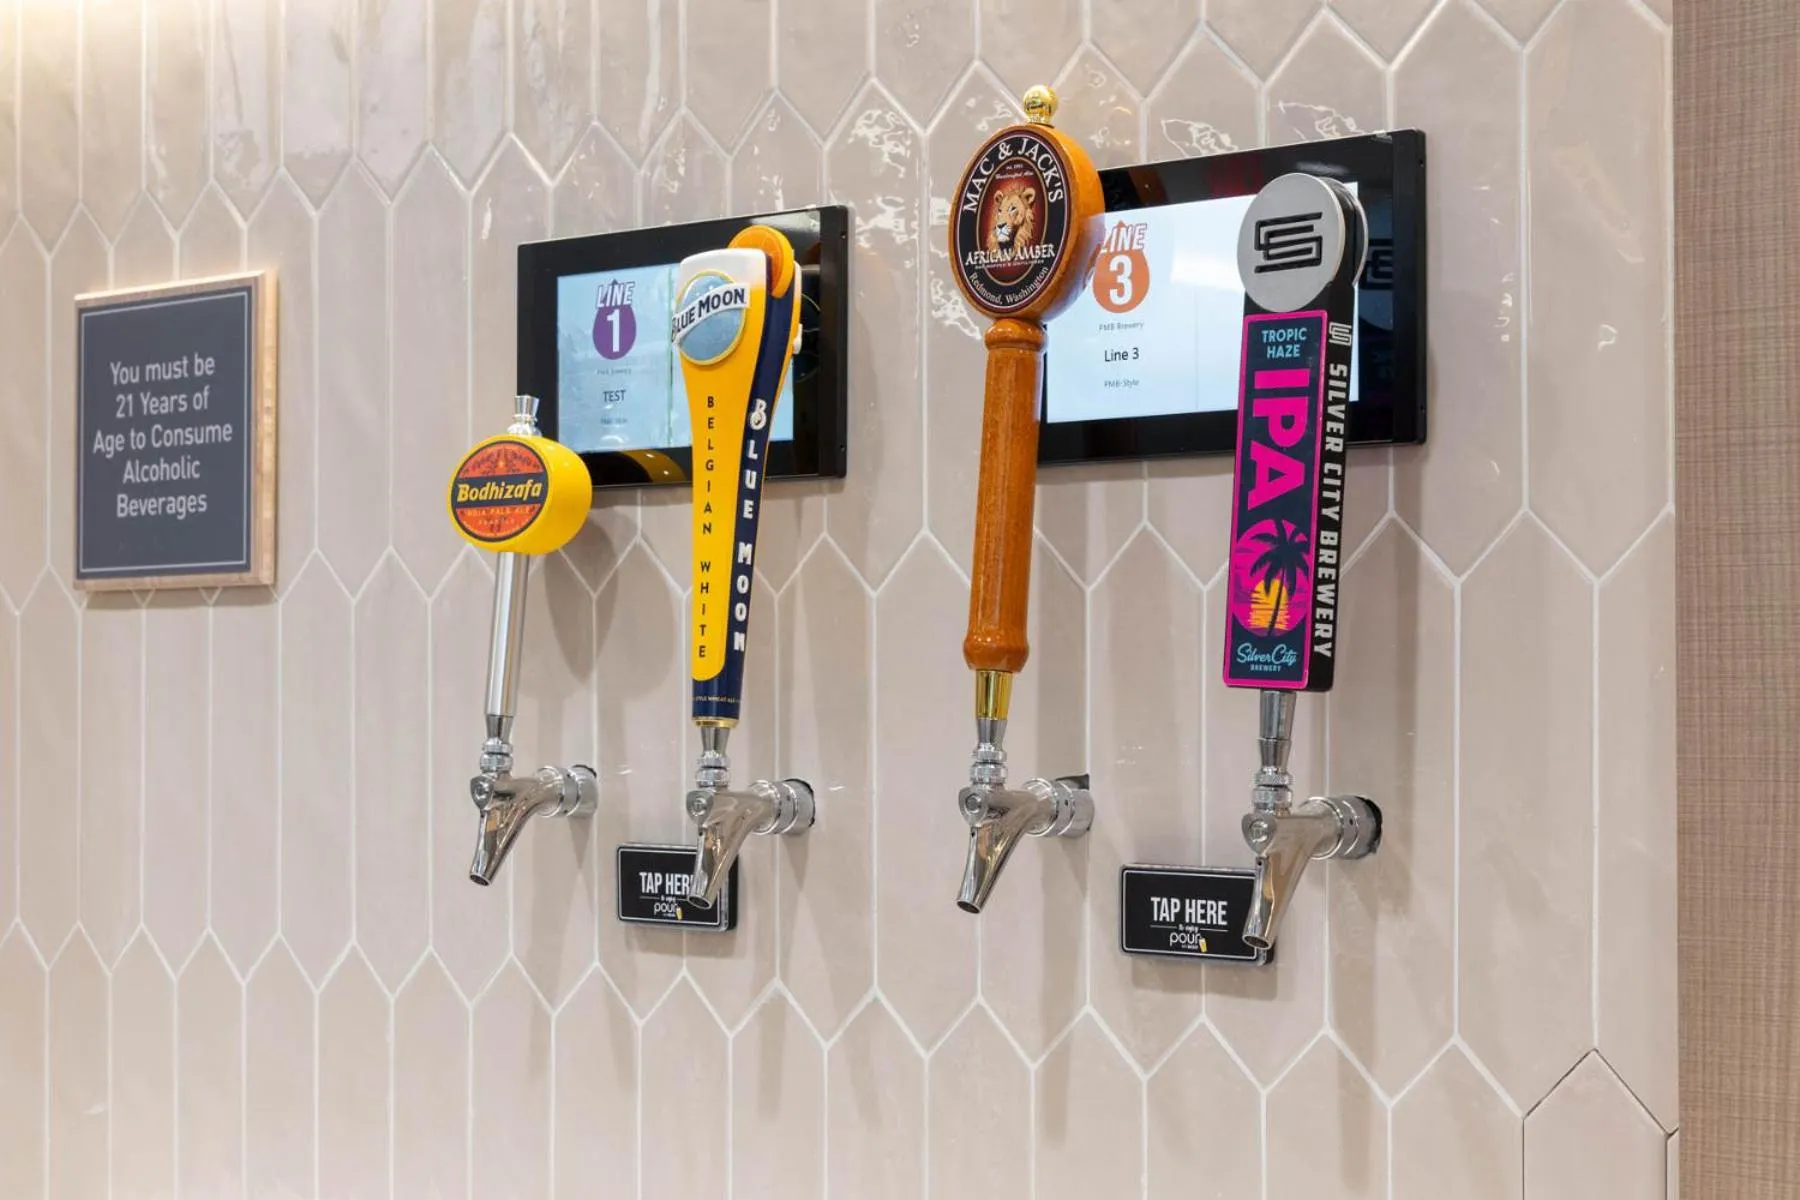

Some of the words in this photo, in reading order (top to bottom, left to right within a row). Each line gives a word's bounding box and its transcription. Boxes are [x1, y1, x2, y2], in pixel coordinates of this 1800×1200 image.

[963, 158, 994, 213] MAC
[997, 142, 1013, 160] &
[1018, 138, 1064, 203] JACK'S
[965, 248, 1012, 266] AFRICAN
[1014, 243, 1056, 260] AMBER
[596, 281, 636, 308] LINE
[1005, 266, 1049, 304] Washington
[1109, 254, 1133, 306] 3
[698, 288, 745, 318] MOON
[606, 308, 620, 353] 1
[1261, 327, 1308, 343] TROPIC
[1104, 349, 1129, 362] Line
[1132, 347, 1140, 360] 3
[1266, 344, 1301, 359] HAZE
[110, 361, 139, 385] You
[145, 356, 189, 382] must
[194, 353, 215, 377] be
[116, 394, 134, 418] 21
[140, 390, 188, 416] Years
[193, 385, 210, 410] of
[603, 389, 627, 403] TEST
[1325, 363, 1348, 453] SILVER
[92, 430, 125, 458] Age
[130, 428, 146, 450] to
[151, 423, 233, 449] Consume
[1248, 368, 1311, 510] IPA
[122, 455, 201, 484] Alcoholic
[702, 396, 715, 535] BELGIAN
[742, 398, 767, 520] BLUE
[116, 492, 207, 520] Beverages
[457, 479, 543, 502] Bodhizafa
[1321, 462, 1342, 521] CITY
[698, 561, 711, 658] WHITE
[733, 541, 753, 653] MOON
[1313, 530, 1339, 658] BREWERY
[639, 872, 663, 893] TAP
[653, 902, 678, 916] pour
[1150, 897, 1181, 922] TAP
[1185, 899, 1228, 925] HERE
[1169, 932, 1201, 947] pour
